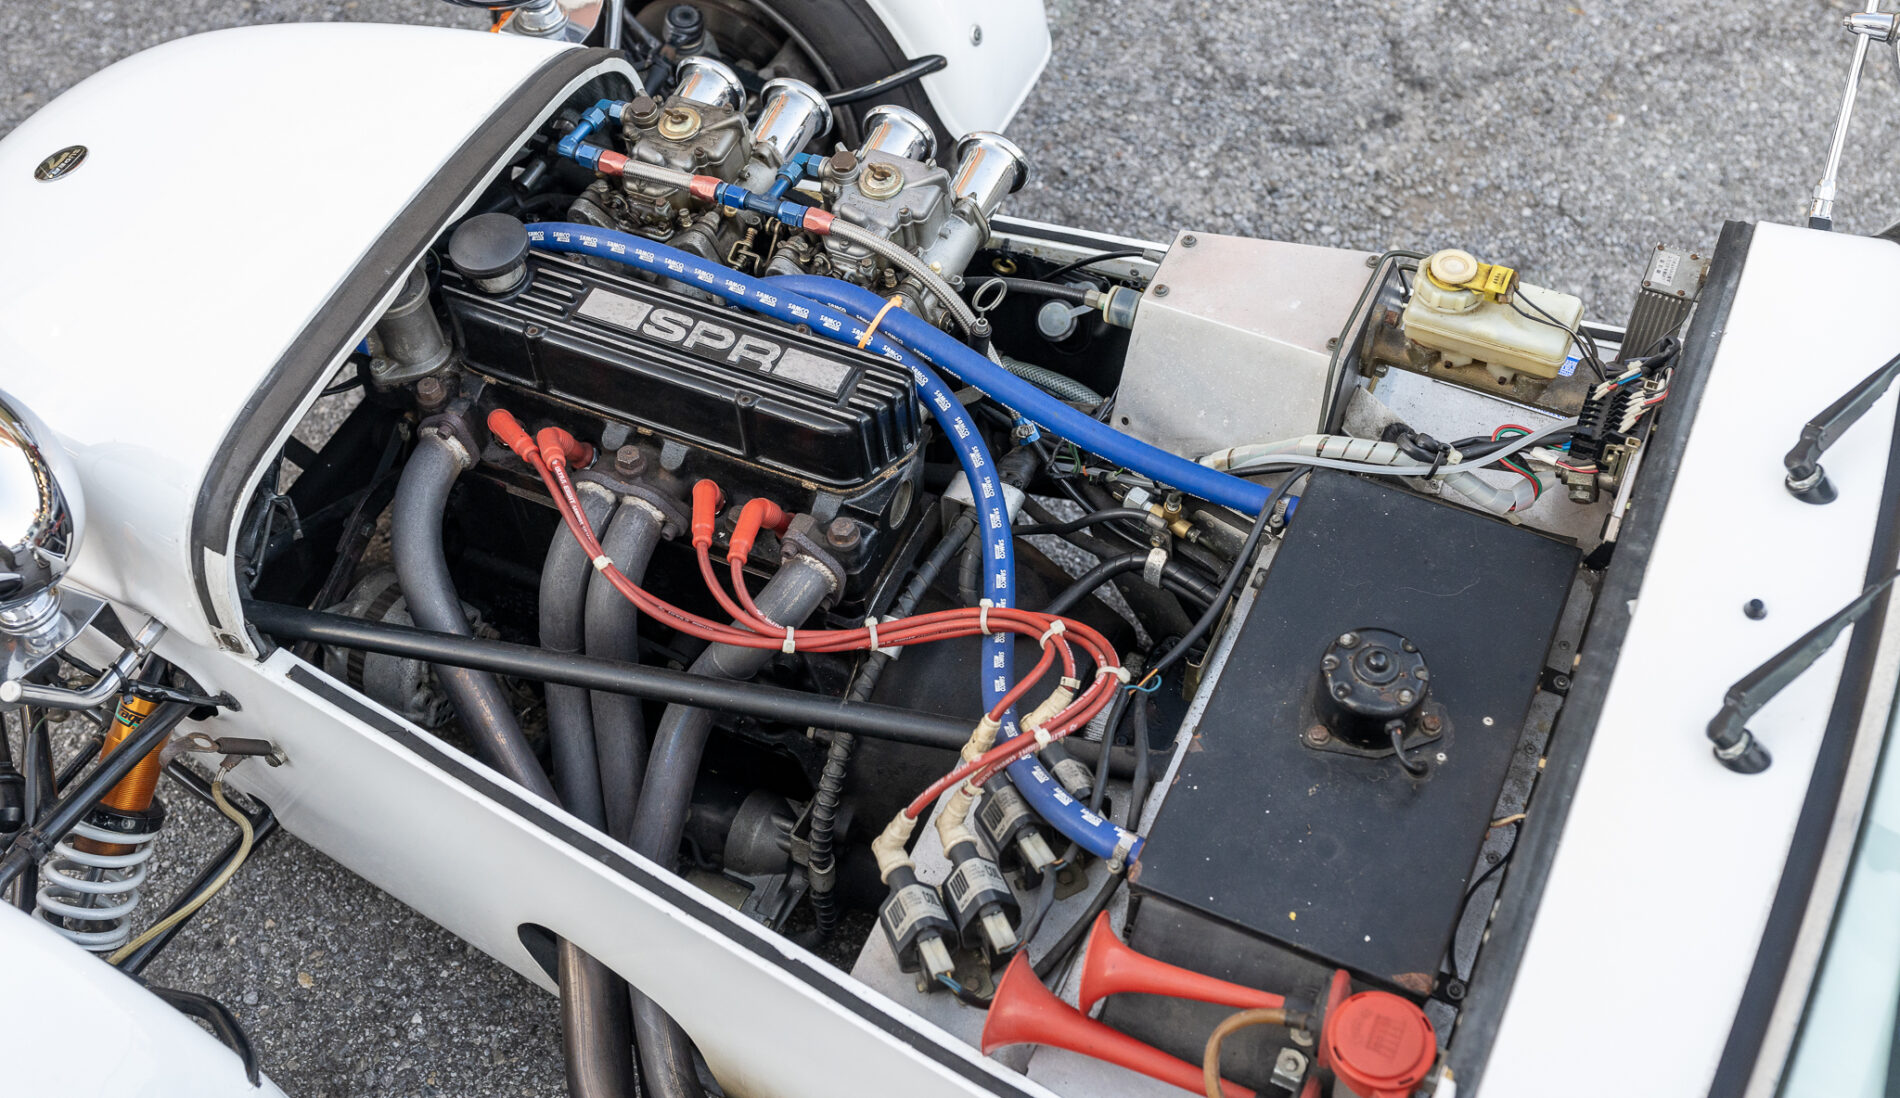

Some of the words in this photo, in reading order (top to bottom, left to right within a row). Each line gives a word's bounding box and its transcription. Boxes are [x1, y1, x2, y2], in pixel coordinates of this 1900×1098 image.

[579, 235, 598, 243] SAMCO
[607, 240, 625, 250] SAMCO
[634, 248, 654, 259] SAMCO
[664, 257, 684, 269] SAMCO
[694, 268, 714, 280] SAMCO
[724, 279, 745, 292] SAMCO
[755, 291, 777, 304] SAMCO
[787, 303, 809, 316] SAMCO
[819, 314, 841, 328] SAMCO
[642, 308, 781, 372] SPR
[882, 344, 902, 361] SAMCO
[934, 390, 951, 409] SAMCO
[954, 416, 970, 436] SAMCO
[971, 445, 984, 466] SAMCO
[984, 476, 995, 497] SAMCO
[992, 507, 1002, 528] SAMCO
